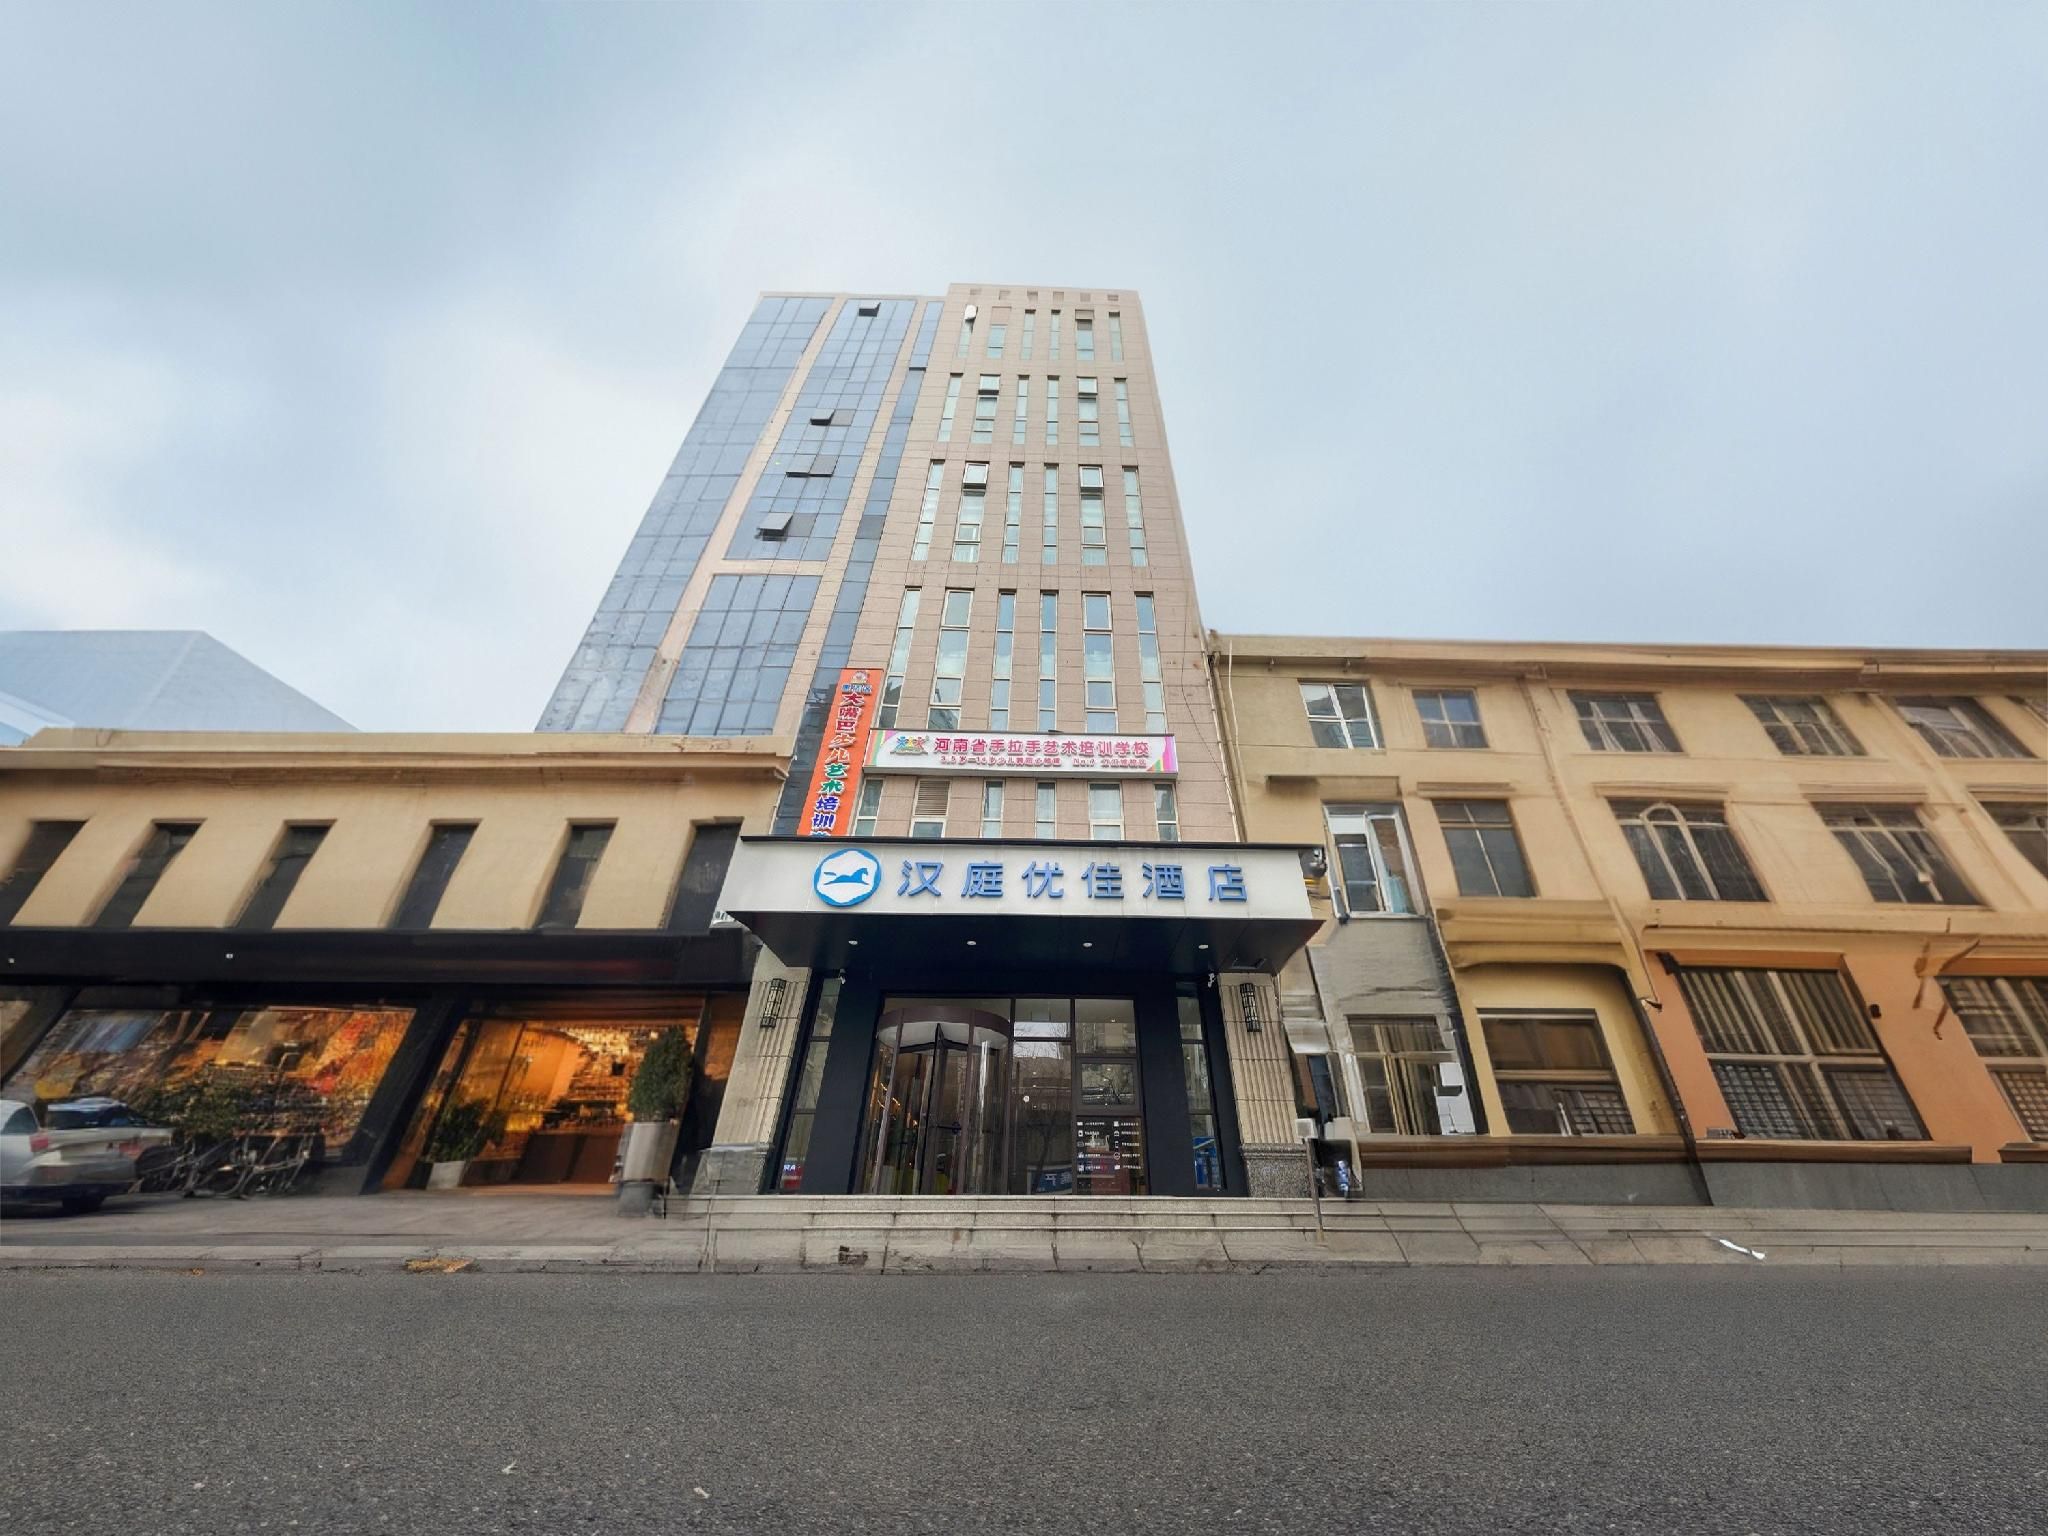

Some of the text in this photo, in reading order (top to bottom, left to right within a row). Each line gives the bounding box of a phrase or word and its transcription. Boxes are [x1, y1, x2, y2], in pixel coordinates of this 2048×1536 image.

[934, 738, 1150, 756] 河南省手拉手艺术培训学校
[897, 860, 1248, 902] 汉庭优佳酒店
